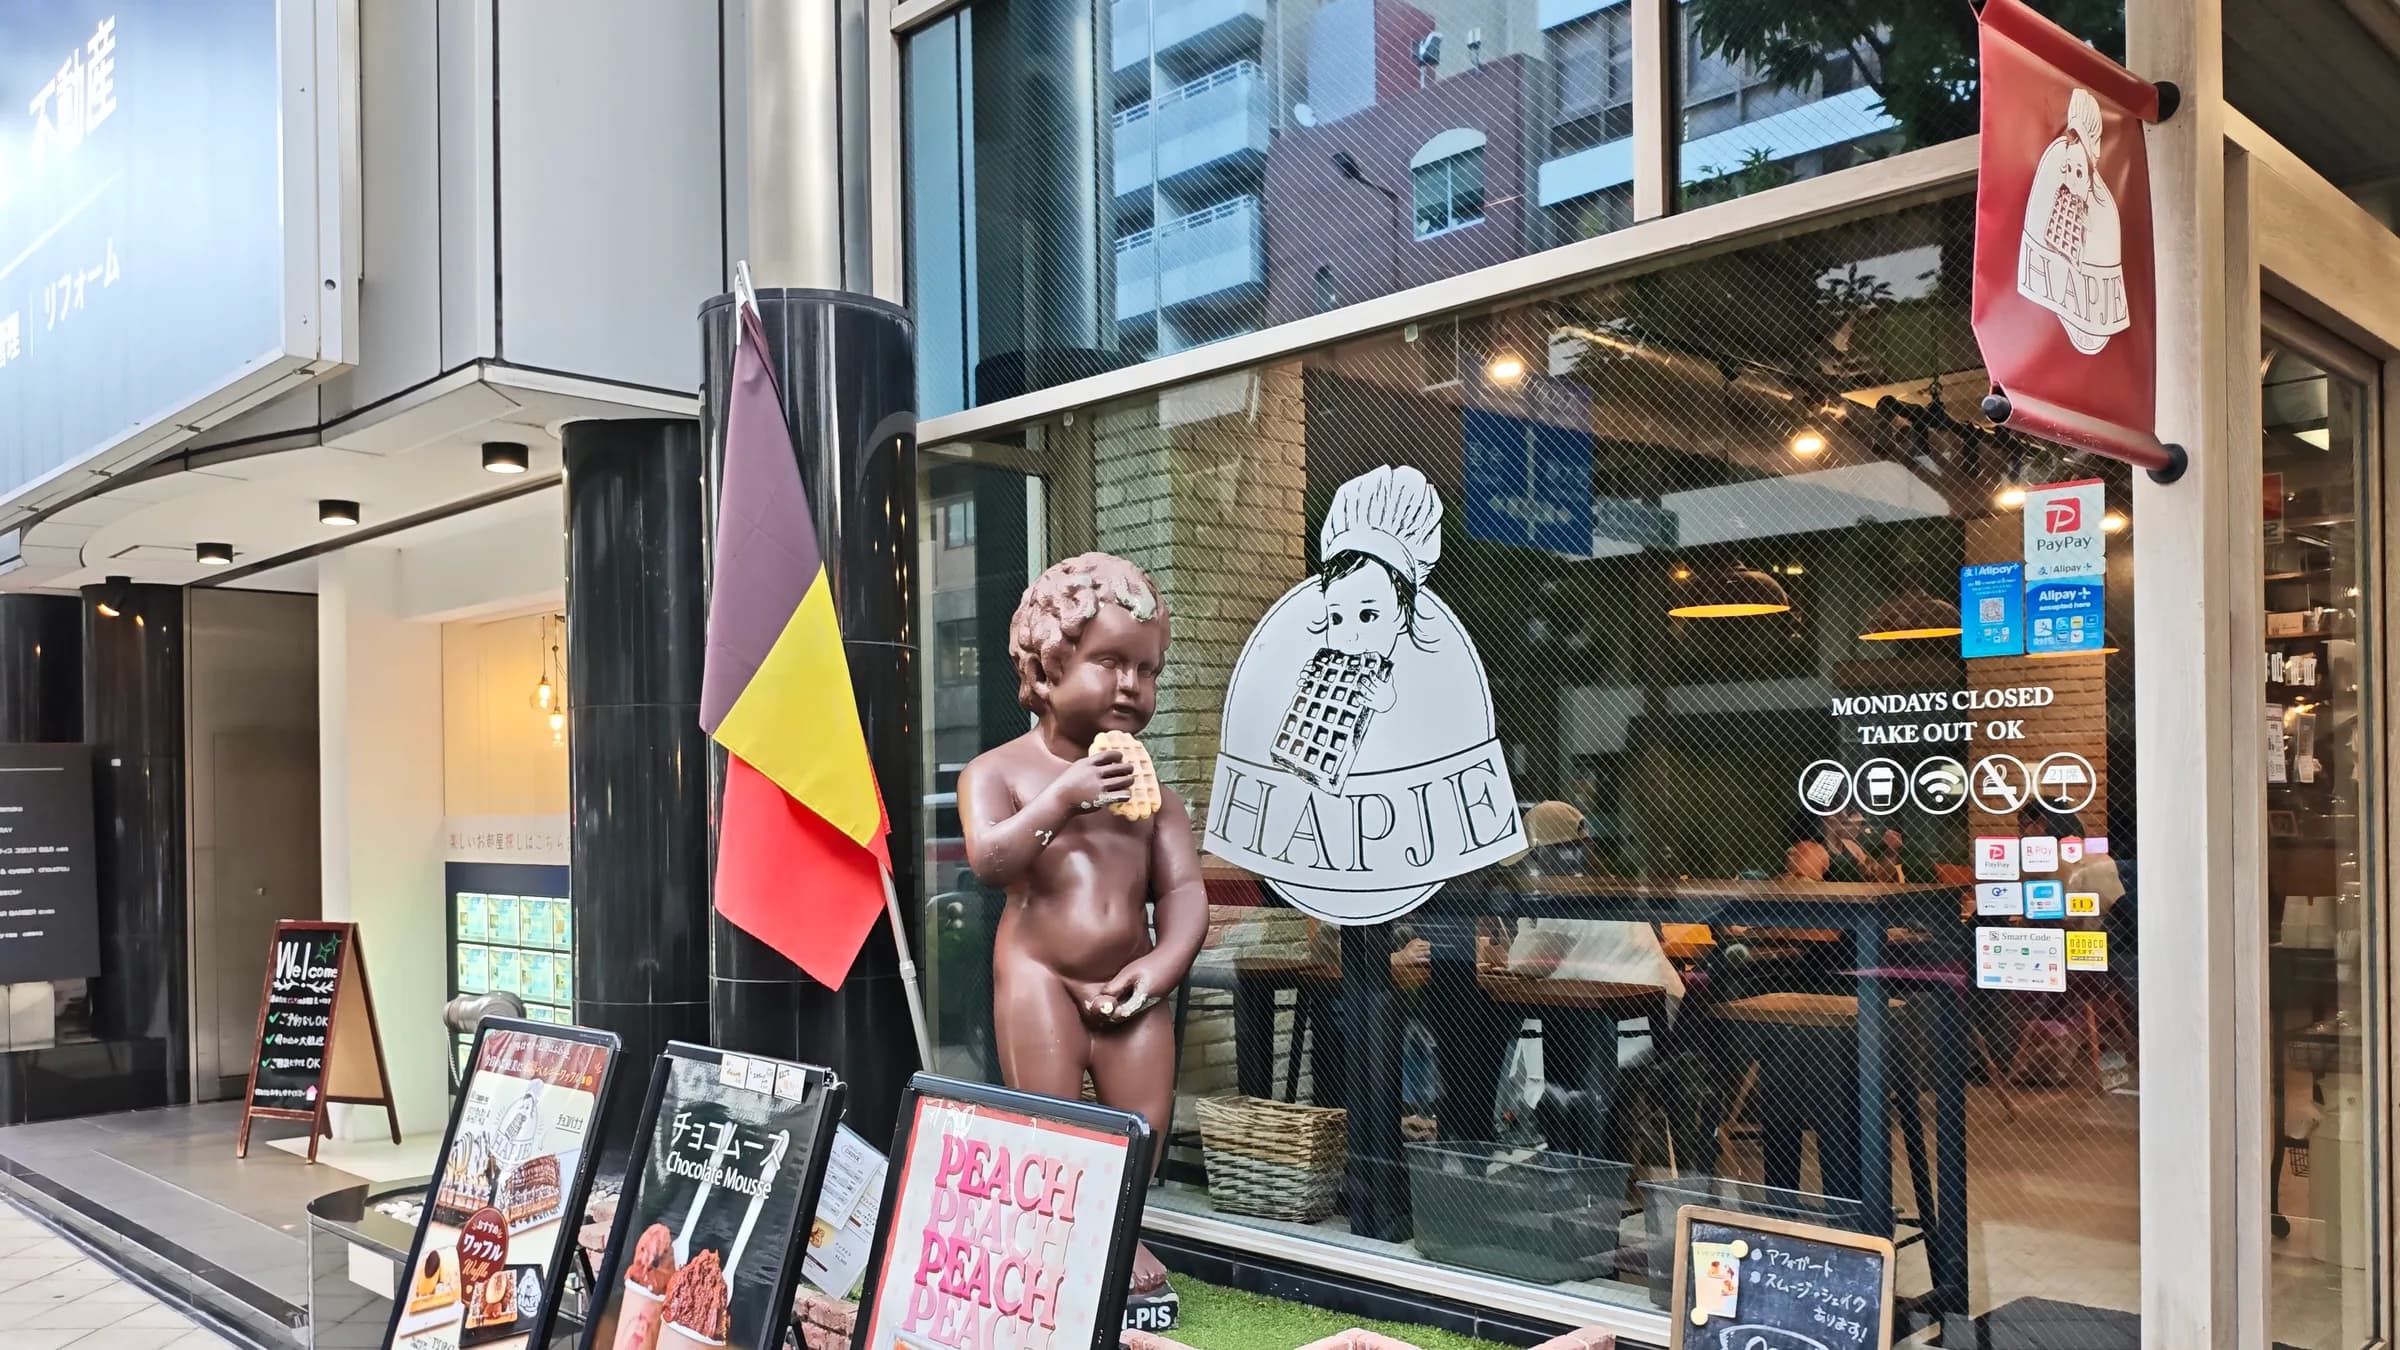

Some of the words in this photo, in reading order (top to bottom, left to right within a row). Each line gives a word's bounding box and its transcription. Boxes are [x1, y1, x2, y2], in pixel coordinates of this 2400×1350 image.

[44, 236, 121, 333] リフォーム
[2021, 241, 2127, 326] HAPJE
[2036, 535, 2093, 552] PayPay
[1831, 692, 1949, 716] MONDAYS
[1951, 686, 2054, 710] CLOSED
[1857, 724, 1920, 745] TAKE
[1923, 721, 1978, 743] OUT
[1986, 719, 2025, 740] OK
[1208, 758, 1518, 872] HAPJE
[2001, 932, 2027, 941] Smart
[2029, 932, 2051, 941] Code
[2070, 938, 2104, 949] nanaco
[275, 941, 339, 981] Welcome
[671, 1111, 786, 1170] チョコムース
[666, 1151, 723, 1186] Chocolate
[722, 1166, 773, 1200] Mousse
[935, 1133, 1084, 1223] PEACH
[463, 1233, 504, 1262] ワッフル
[925, 1186, 1076, 1276] PEACH
[914, 1227, 1065, 1331] PEACH
[1766, 1249, 1834, 1278] アフォガート
